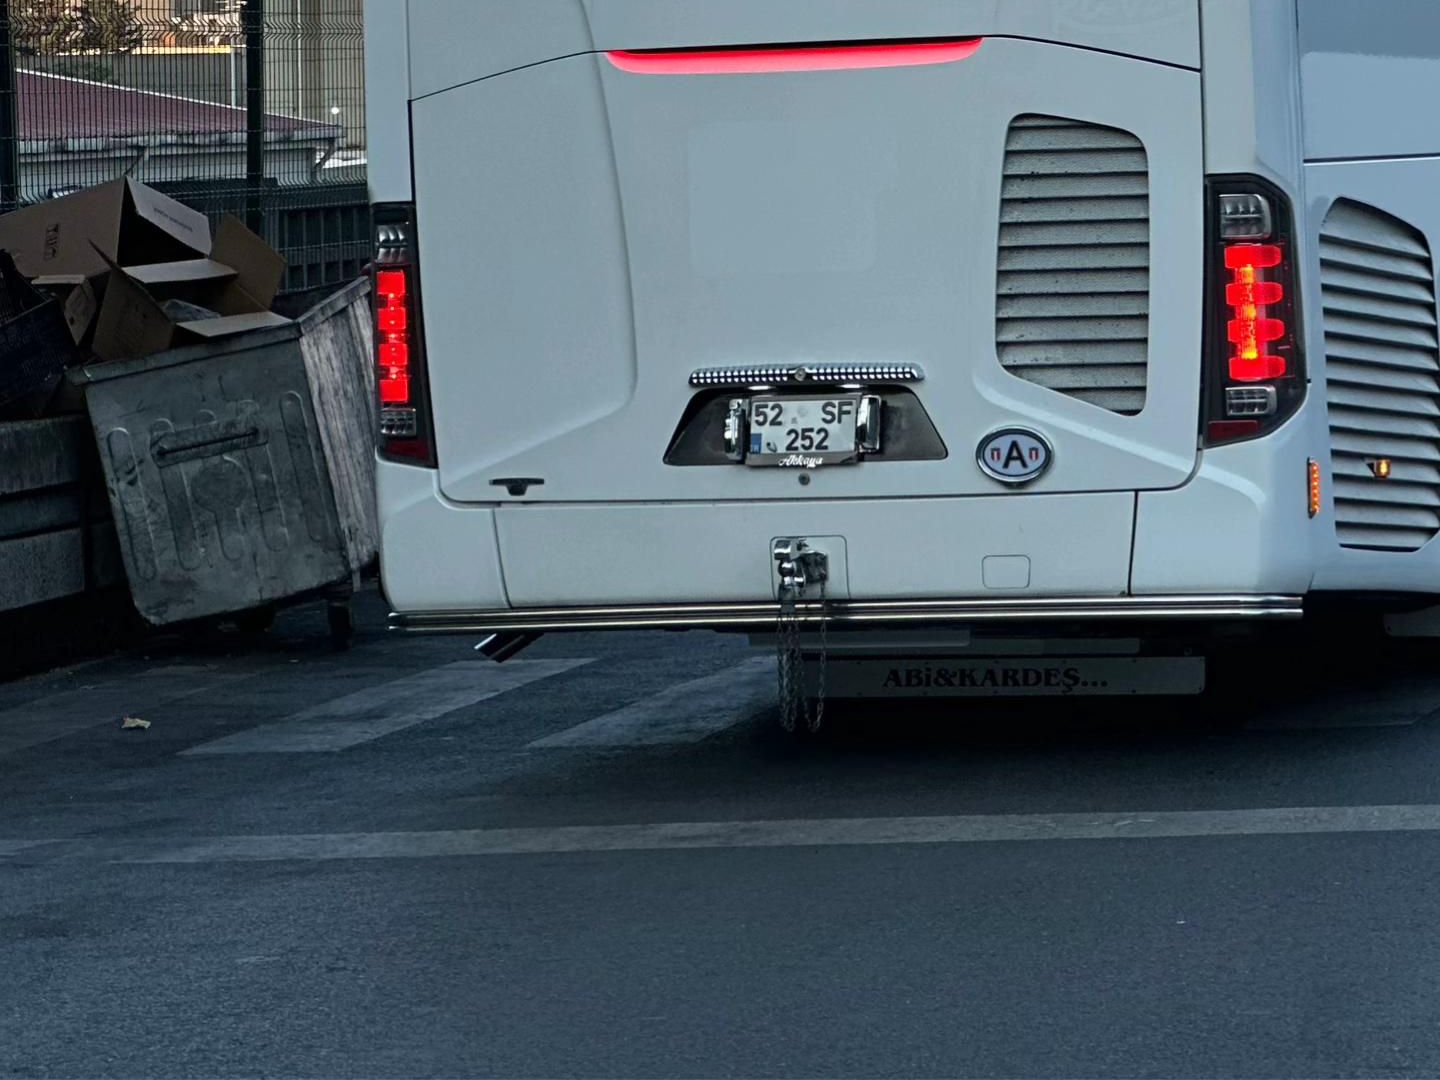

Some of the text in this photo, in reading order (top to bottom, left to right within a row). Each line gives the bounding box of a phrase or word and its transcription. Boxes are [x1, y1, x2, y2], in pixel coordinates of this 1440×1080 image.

[754, 401, 853, 426] 52 SF
[785, 427, 829, 451] 252
